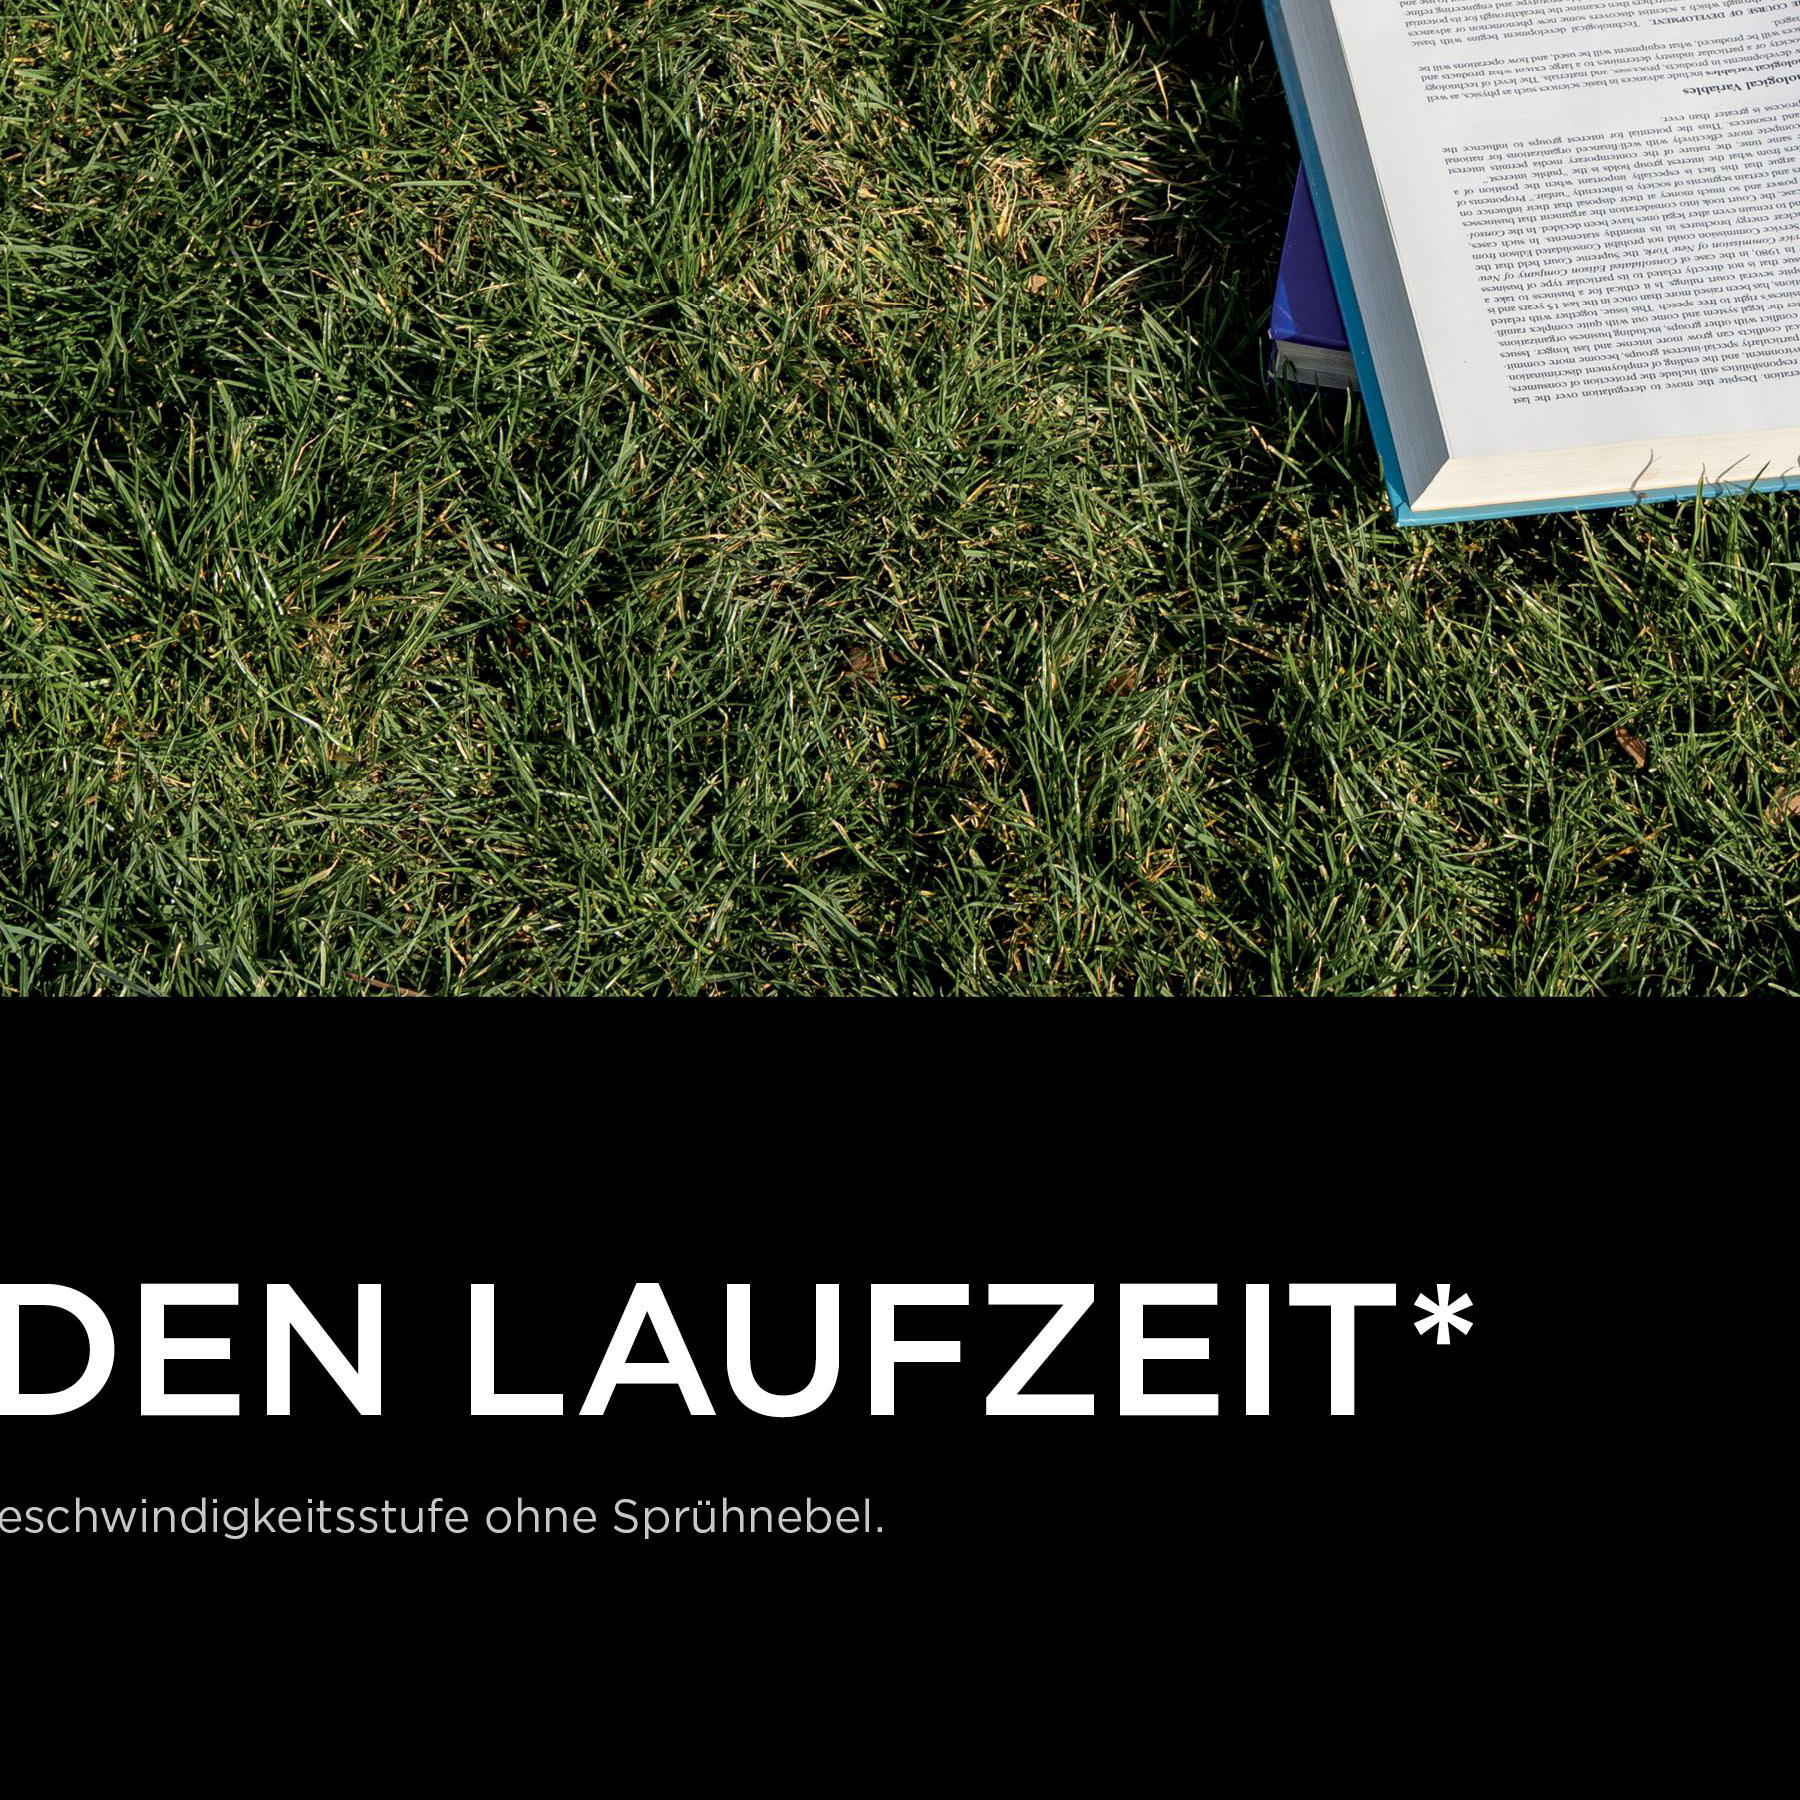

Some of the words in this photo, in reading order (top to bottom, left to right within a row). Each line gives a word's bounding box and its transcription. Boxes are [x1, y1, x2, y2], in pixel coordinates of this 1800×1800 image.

[1728, 9, 1745, 18] OF
[1746, 2, 1789, 16] COURSE
[1570, 18, 1640, 34] Technological
[1465, 32, 1500, 43] begins
[1502, 25, 1568, 40] development
[1411, 39, 1437, 48] basic
[1439, 37, 1464, 46] with
[1665, 70, 1705, 81] include
[1704, 65, 1755, 78] variables
[1581, 79, 1609, 89] basic
[1608, 78, 1620, 86] in
[1619, 73, 1666, 85] advances
[1513, 86, 1539, 96] such
[1538, 82, 1582, 93] sciences
[1681, 82, 1742, 97] Variables
[1426, 94, 1449, 103] well
[1460, 88, 1502, 101] physics,
[1727, 151, 1755, 161] what
[1755, 147, 1782, 158] from
[1631, 158, 1665, 169] group
[1666, 156, 1706, 167] interest
[1707, 154, 1726, 163] the
[1570, 167, 1589, 176] the
[1590, 166, 1601, 174] is
[1601, 163, 1632, 173] holds
[1666, 233, 1697, 243] could
[1697, 227, 1762, 241] Commission
[1602, 236, 1646, 250] prohibit
[1646, 236, 1666, 244] not
[1497, 249, 1534, 260] Edison
[1534, 242, 1603, 257] Consolidated
[1738, 250, 1750, 258] in
[1783, 246, 1796, 254] In
[1471, 252, 1498, 262] from
[1679, 256, 1693, 265] of
[1693, 253, 1717, 262] case
[1717, 251, 1737, 261] the
[1570, 264, 1608, 275] Edison
[1608, 257, 1679, 272] Consolidated
[1477, 274, 1503, 283] New
[1502, 272, 1516, 281] of
[1515, 266, 1569, 280] Company
[1732, 316, 1759, 327] with
[1758, 312, 1799, 324] conflict
[1662, 319, 1703, 332] groups,
[1702, 319, 1733, 330] other
[1567, 331, 1613, 343] business
[1612, 324, 1663, 339] including
[1739, 333, 1800, 349] particularly
[1620, 347, 1661, 359] groups,
[1660, 339, 1740, 357] special-interest
[1547, 357, 1577, 366] more
[1577, 353, 1621, 365] become
[1719, 356, 1799, 374] responsibilities
[1657, 368, 1698, 380] include
[1699, 366, 1720, 376] still
[1581, 372, 1639, 387] protection
[1638, 372, 1658, 382] the
[1716, 372, 1759, 386] Despite
[1509, 380, 1569, 393] consumers,
[1569, 379, 1582, 389] of
[1649, 383, 1662, 391] to
[1664, 380, 1695, 390] move
[1696, 378, 1716, 388] the
[1553, 391, 1579, 400] over
[1580, 382, 1648, 399] deregulation
[1512, 396, 1532, 406] last
[1533, 394, 1552, 404] the
